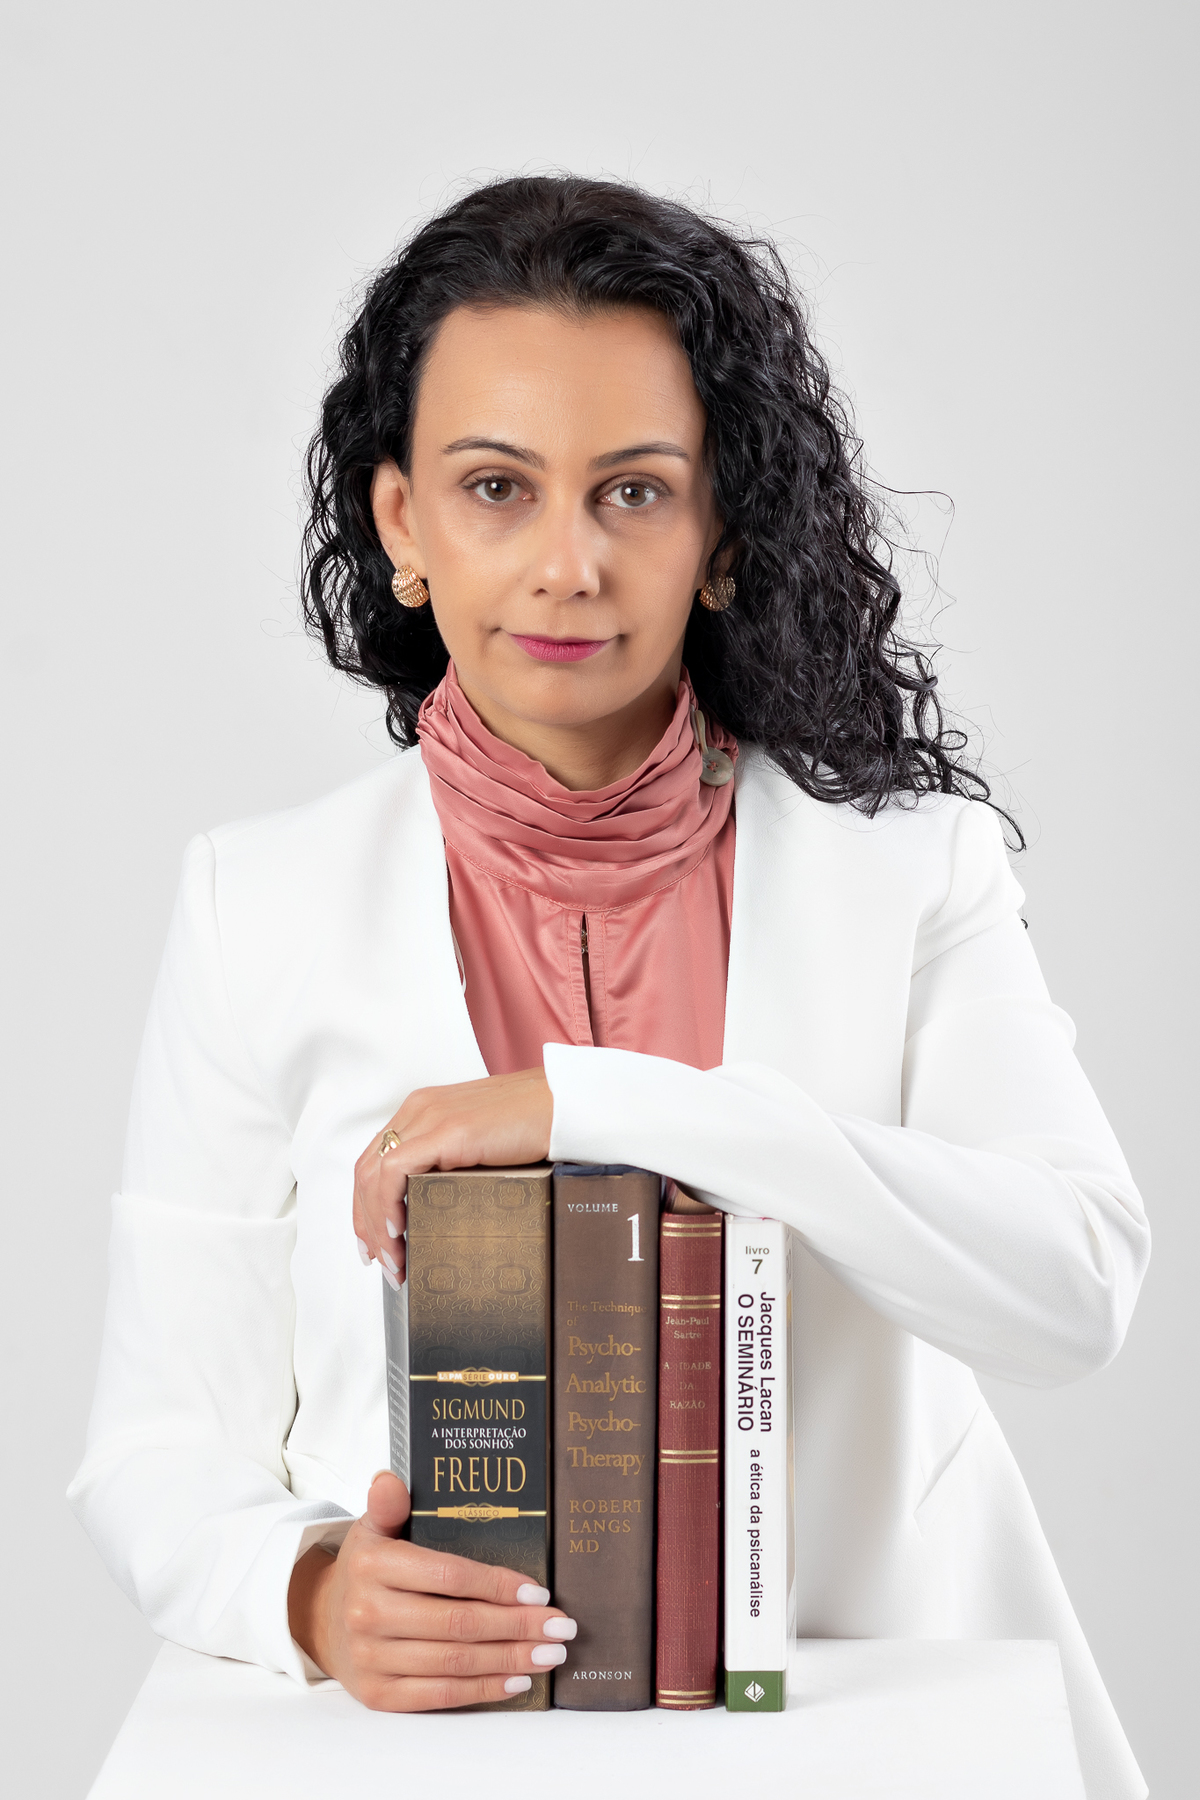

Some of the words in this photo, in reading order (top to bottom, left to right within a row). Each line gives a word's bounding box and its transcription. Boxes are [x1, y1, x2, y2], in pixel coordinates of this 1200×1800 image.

[567, 1203, 619, 1213] VOLUME
[627, 1213, 645, 1262] 1
[745, 1246, 770, 1255] livro
[752, 1259, 763, 1275] 7
[567, 1300, 588, 1312] The
[590, 1300, 647, 1317] Technique
[737, 1293, 754, 1309] O
[566, 1316, 580, 1327] of
[665, 1316, 710, 1326] Jean-Paul
[673, 1330, 702, 1339] Sartre
[756, 1291, 776, 1370] Jacques
[567, 1334, 642, 1364] Psycho-
[663, 1361, 670, 1370] A
[679, 1361, 712, 1370] IDADE
[737, 1315, 758, 1432] SEMINÁRIO
[463, 1372, 487, 1381] SÉRIE
[564, 1371, 647, 1402] Analytic
[680, 1381, 695, 1390] DA
[432, 1398, 526, 1421] SIGMUND
[760, 1377, 776, 1433] Lacan
[567, 1410, 642, 1440] Psycho-
[431, 1428, 439, 1438] A
[441, 1426, 527, 1442] INTERPRETAÇÃO
[445, 1438, 467, 1449] DOS
[469, 1438, 514, 1449] SONHOS
[566, 1446, 646, 1476] Therapy
[750, 1449, 760, 1458] a
[432, 1456, 527, 1493] FREUD
[750, 1462, 763, 1500] ética
[457, 1508, 500, 1517] CLÁSSICO
[569, 1499, 644, 1514] ROBERT
[750, 1505, 763, 1524] da
[569, 1519, 631, 1533] LANGS
[569, 1539, 600, 1553] MD
[747, 1529, 763, 1618] psicanálise
[572, 1671, 632, 1680] ARONSON
